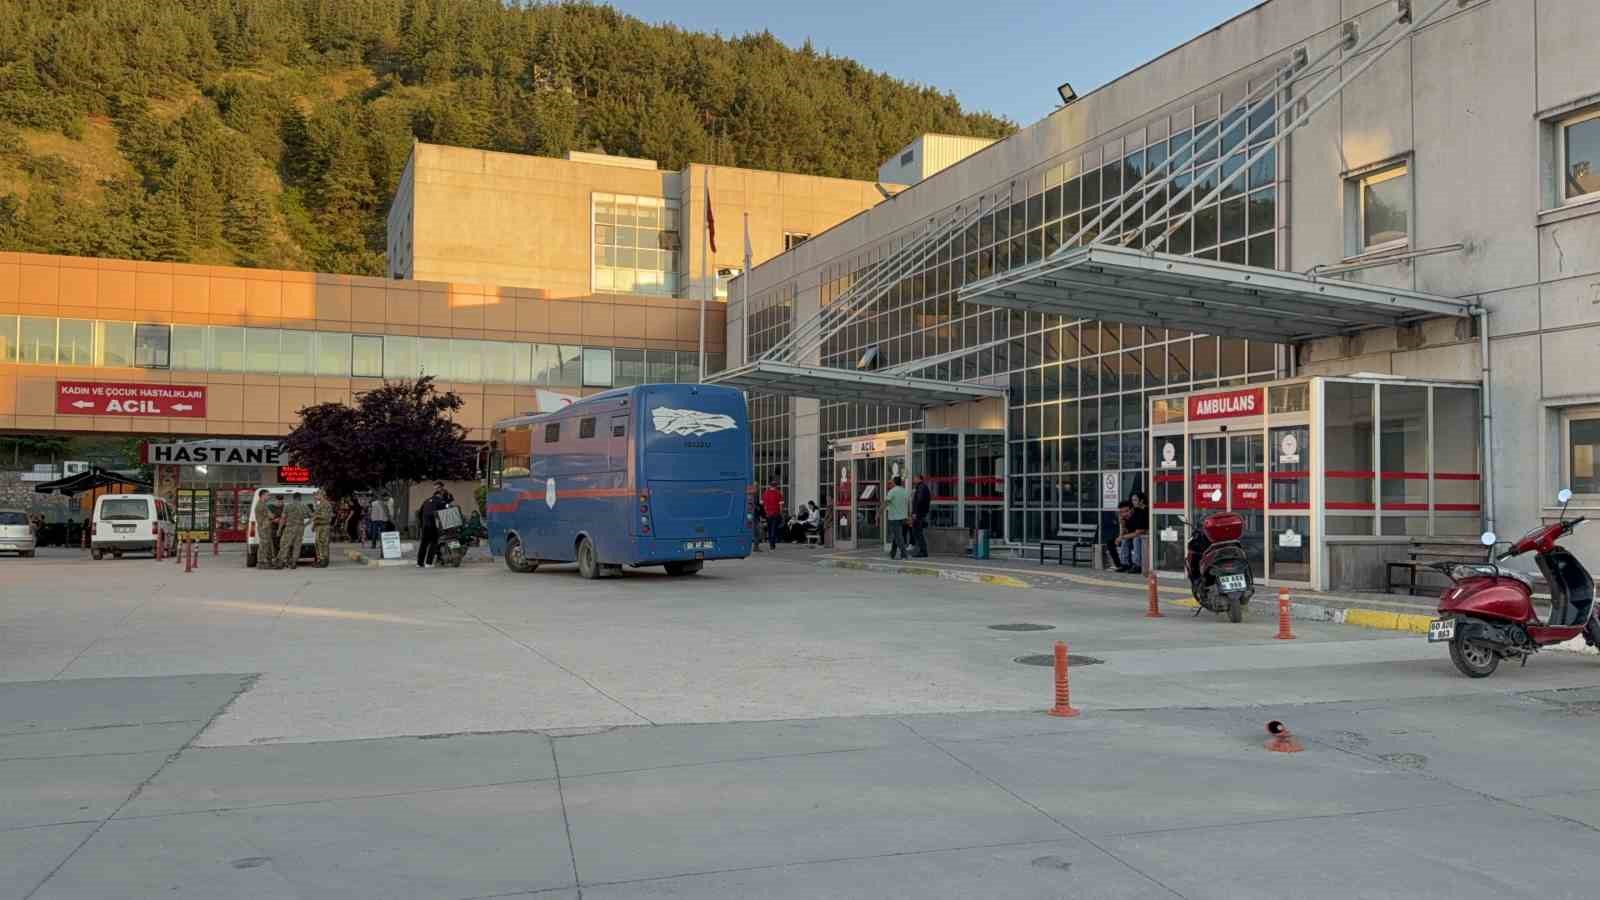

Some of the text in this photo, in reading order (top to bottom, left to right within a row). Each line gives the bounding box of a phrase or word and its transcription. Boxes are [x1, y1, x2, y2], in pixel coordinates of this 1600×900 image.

[61, 386, 202, 398] KADIN VE ÇOCUK HASTALIKLARI
[1196, 394, 1255, 416] AMBULANS
[155, 446, 280, 464] HASTANE
